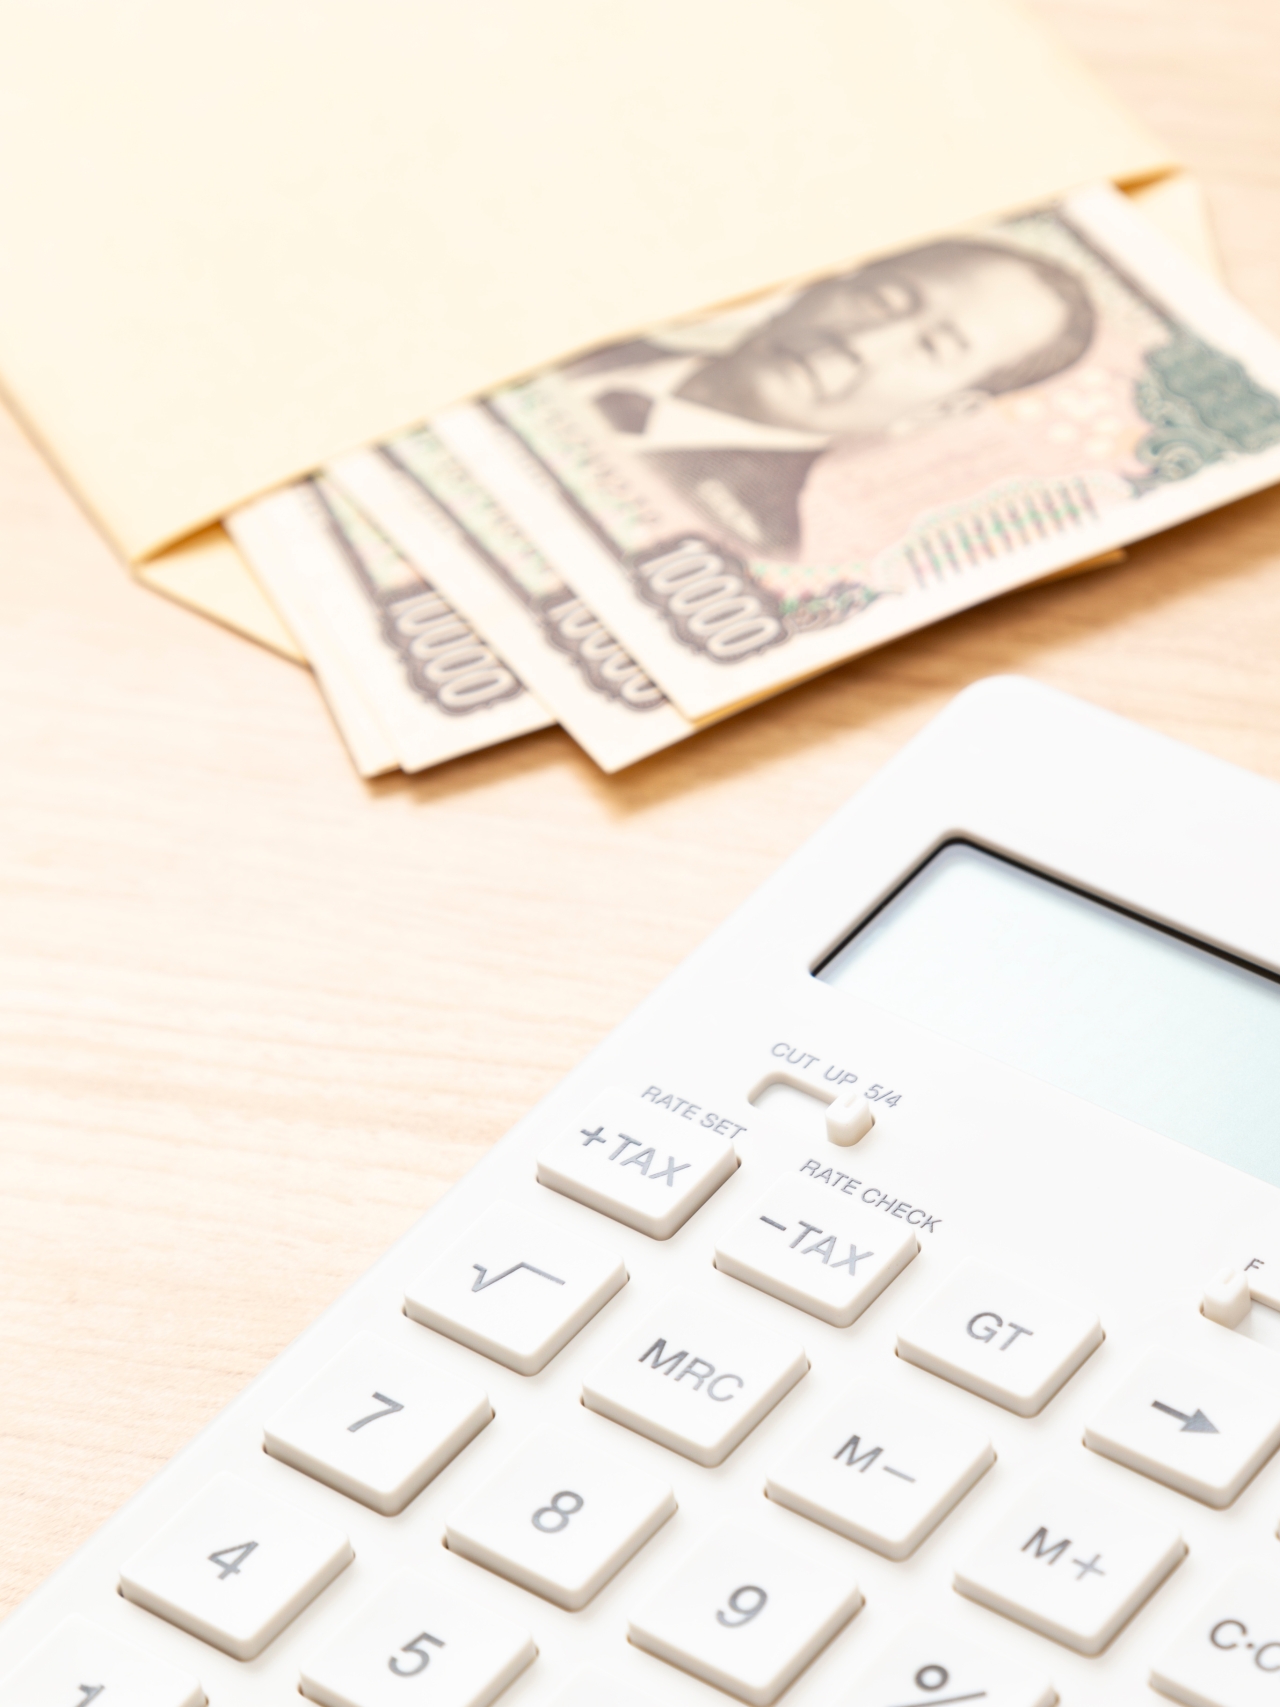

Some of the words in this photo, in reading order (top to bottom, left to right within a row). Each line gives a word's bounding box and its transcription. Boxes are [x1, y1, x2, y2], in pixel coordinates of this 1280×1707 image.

[637, 538, 780, 656] 10000
[771, 1043, 820, 1069] CUT
[824, 1065, 858, 1085] UP
[864, 1084, 902, 1108] 5/4
[641, 1085, 702, 1120] RATE
[700, 1113, 747, 1139] SET
[580, 1126, 691, 1186] +TAX
[800, 1159, 862, 1195] RATE
[862, 1188, 942, 1233] CHECK
[1244, 1258, 1264, 1271] F
[967, 1312, 1033, 1350] GT
[638, 1338, 744, 1402] MRC
[347, 1392, 404, 1433] 7
[531, 1490, 584, 1533] 8
[207, 1541, 259, 1580] 4
[716, 1584, 768, 1628] 9
[388, 1632, 445, 1677] 5
